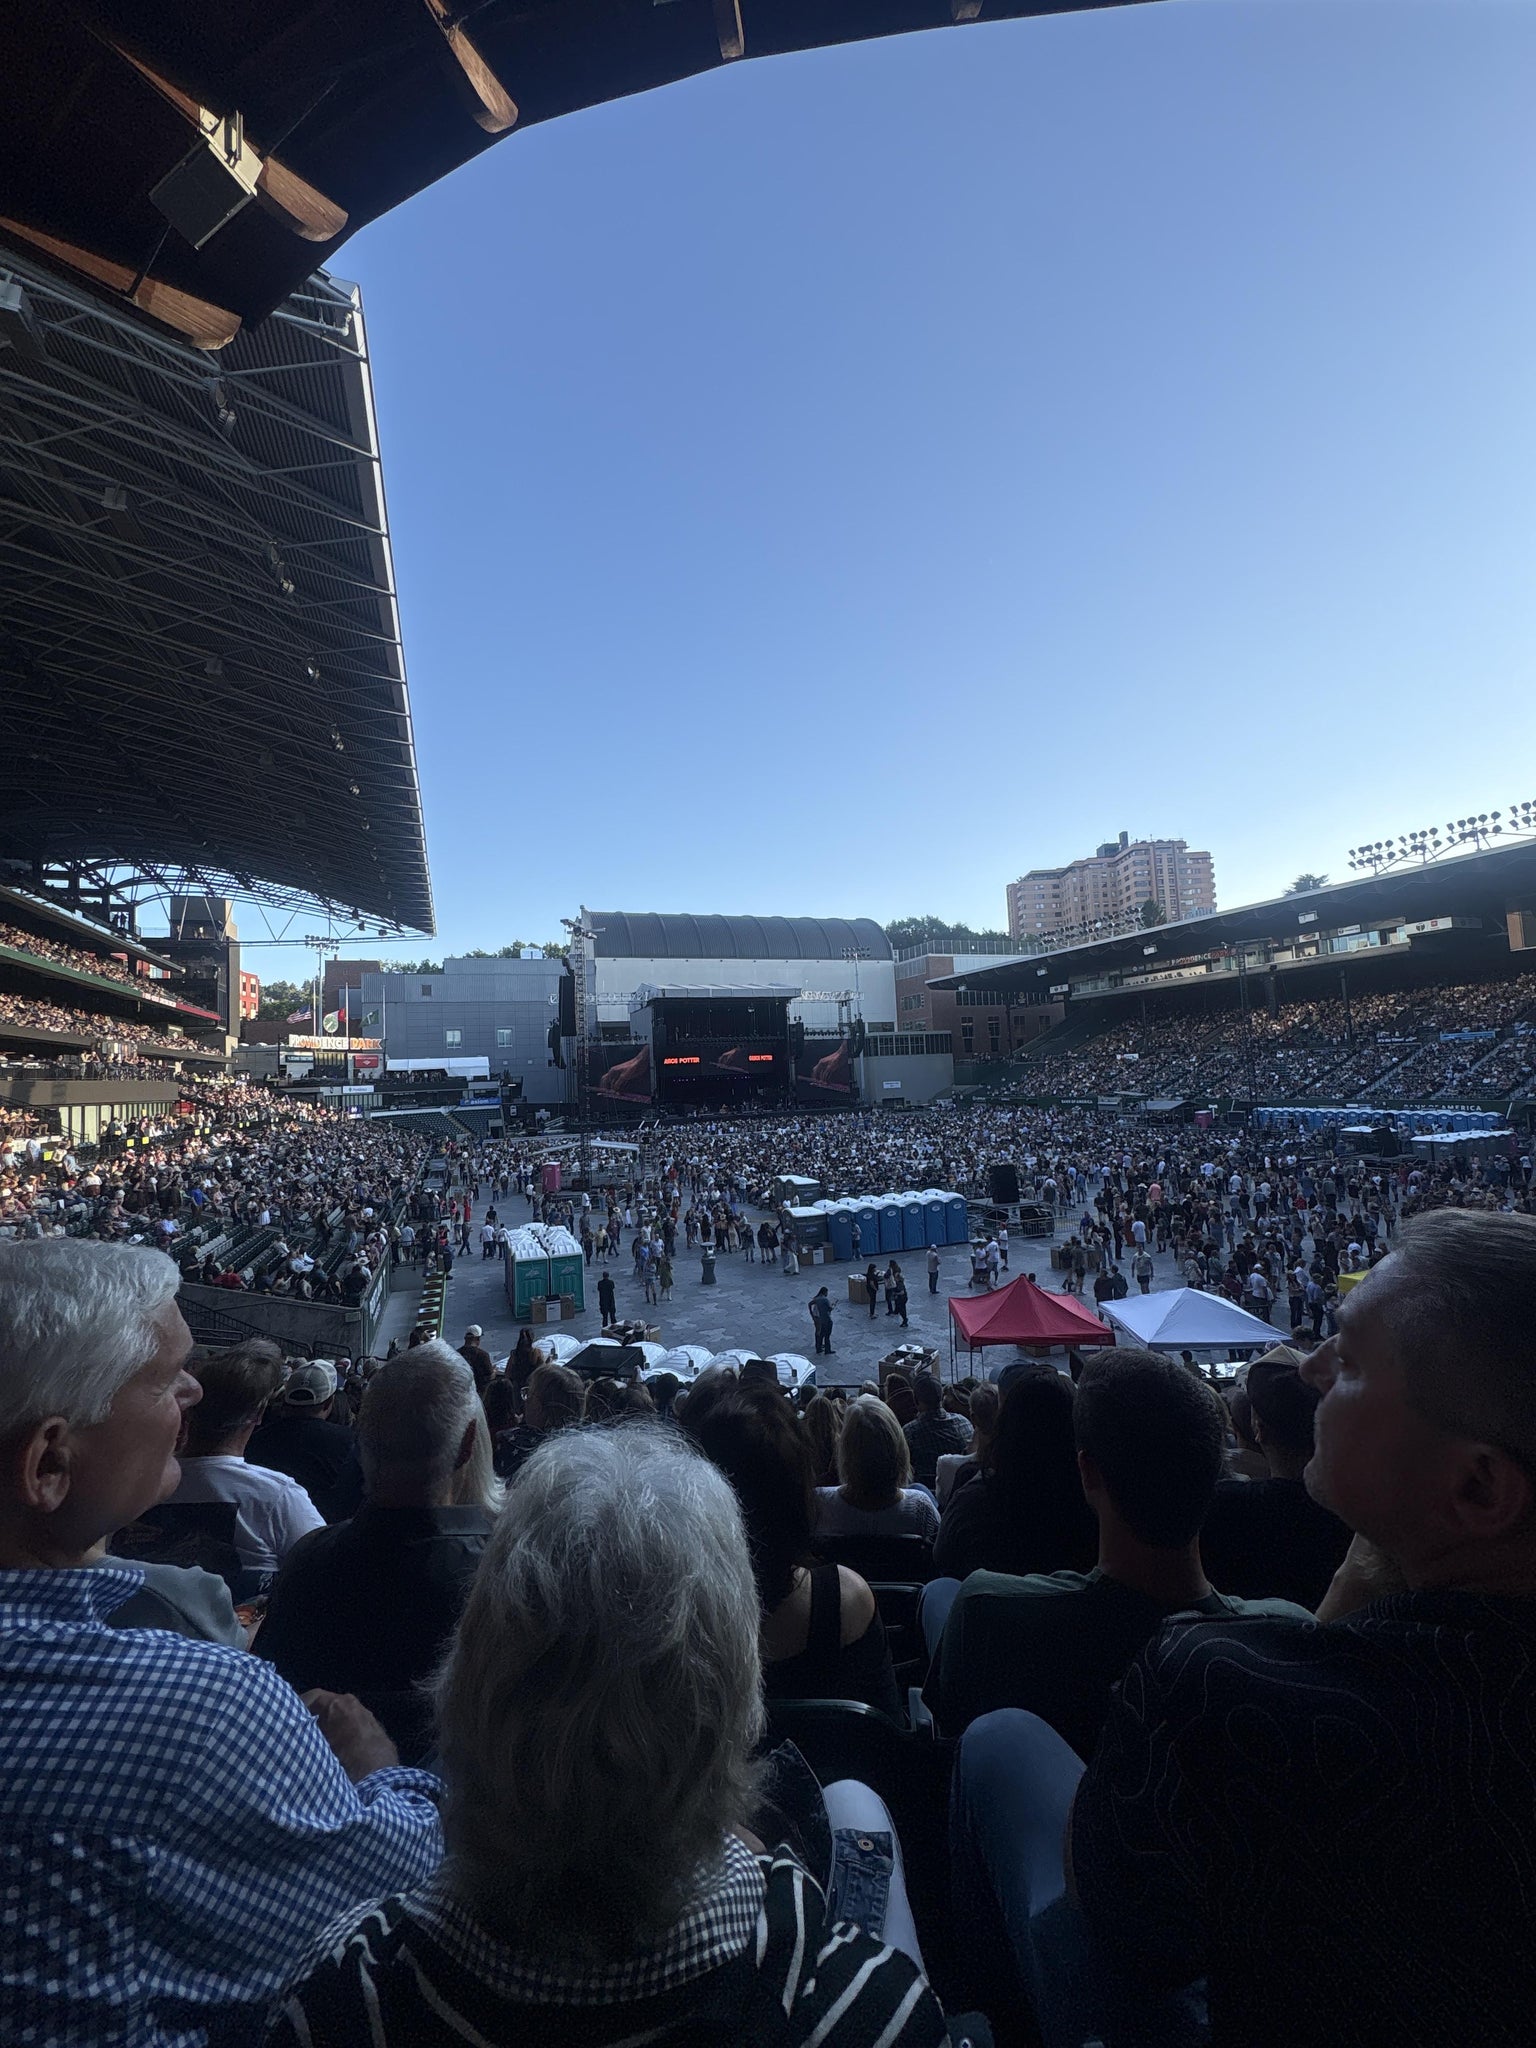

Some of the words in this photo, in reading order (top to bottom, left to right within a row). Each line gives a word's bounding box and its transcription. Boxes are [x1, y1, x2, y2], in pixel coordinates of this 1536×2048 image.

[289, 1034, 348, 1050] PROVIDENCE
[350, 1037, 382, 1050] PARK
[679, 1056, 700, 1064] POTTER
